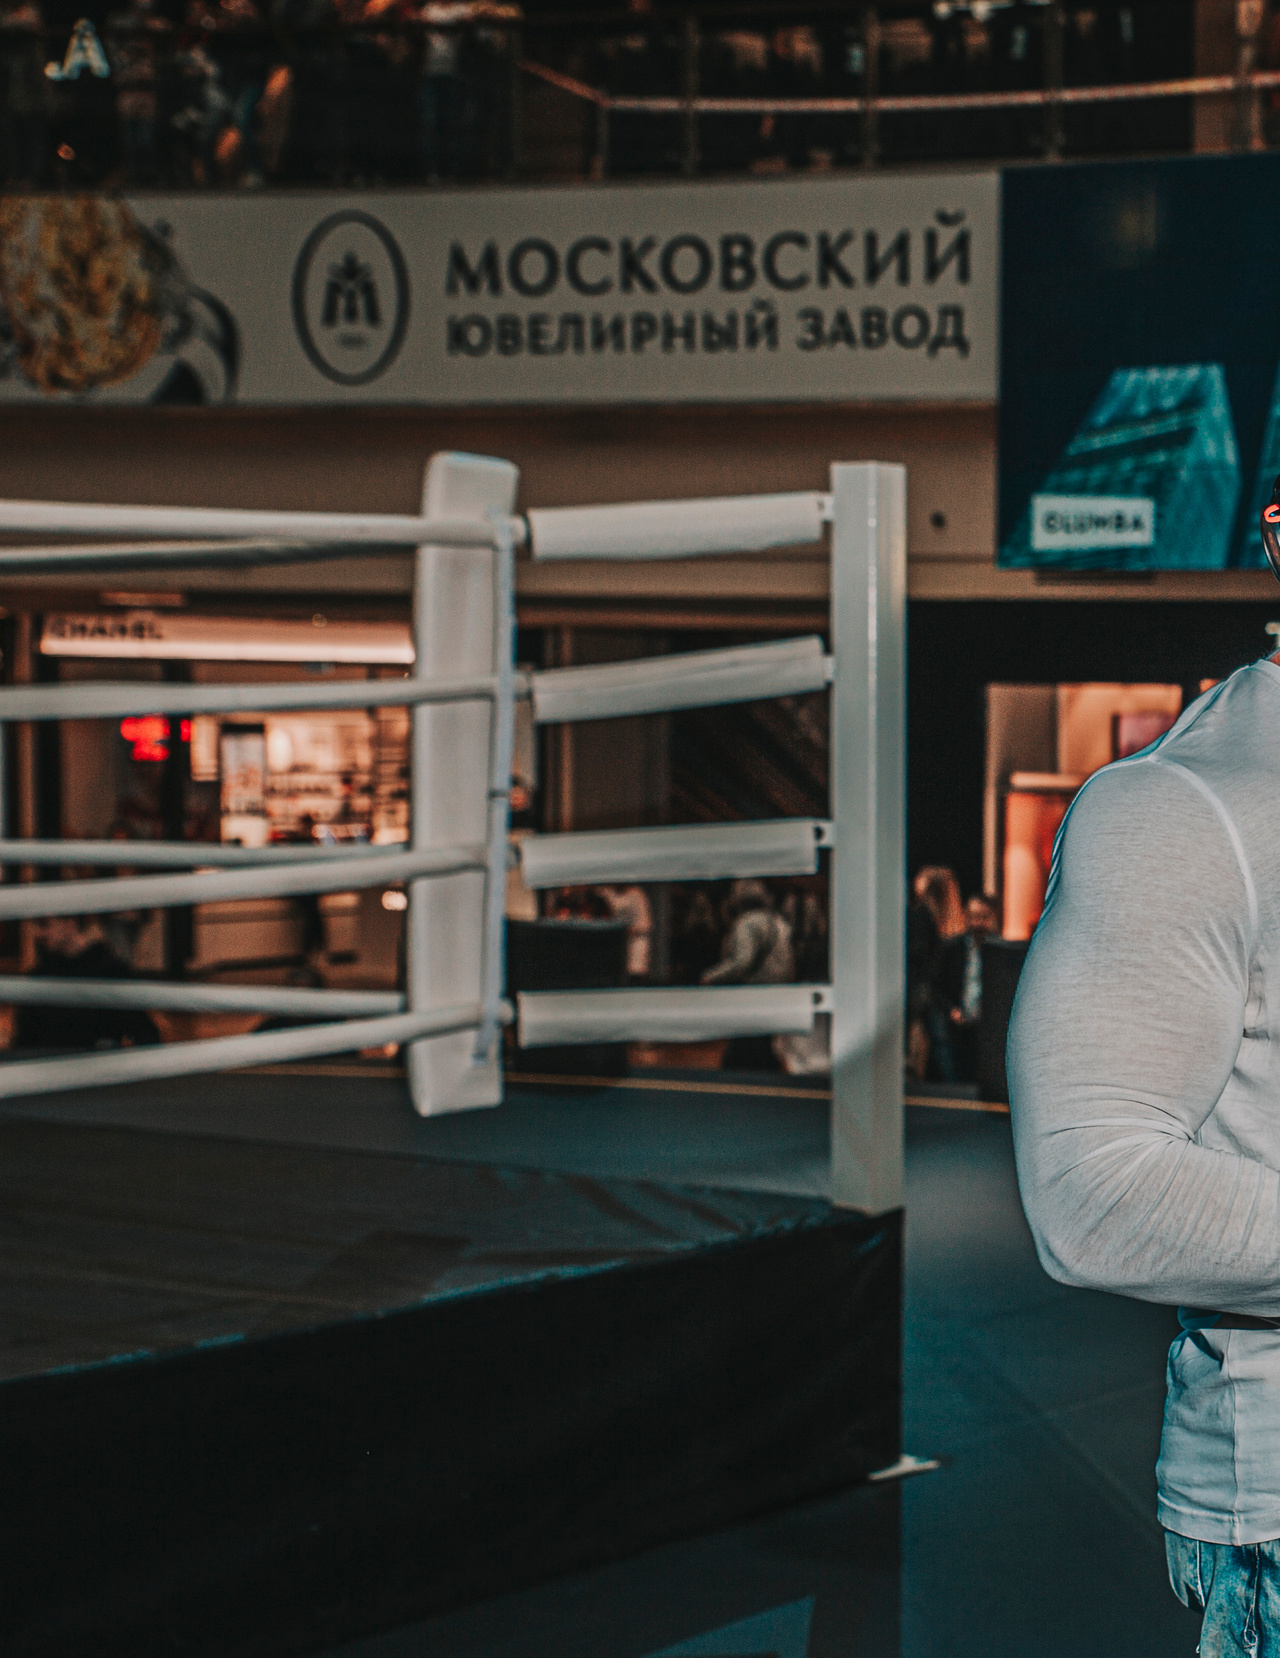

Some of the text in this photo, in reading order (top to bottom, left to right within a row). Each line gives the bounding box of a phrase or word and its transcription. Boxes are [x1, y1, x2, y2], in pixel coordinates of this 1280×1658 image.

[446, 208, 971, 298] МОСКОВСКИЙ
[446, 299, 971, 359] ЮВЕЛИРНЫЙ ЗАВОД
